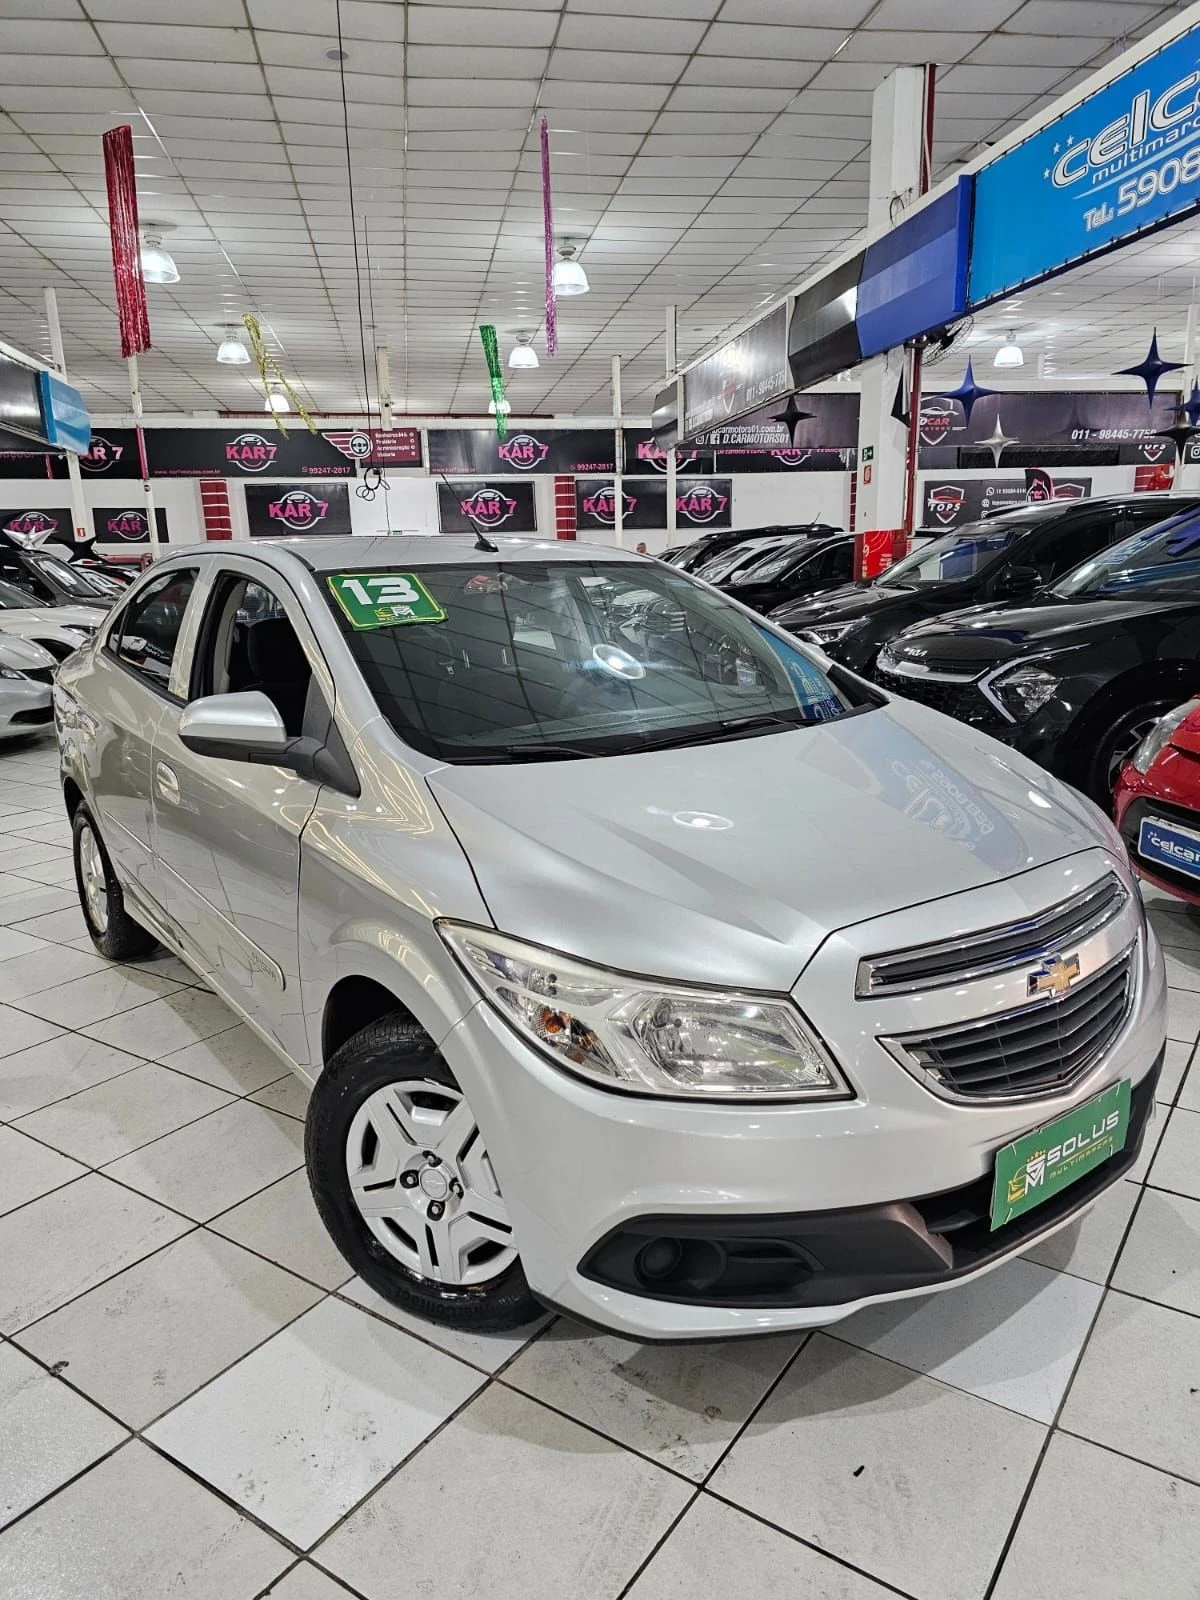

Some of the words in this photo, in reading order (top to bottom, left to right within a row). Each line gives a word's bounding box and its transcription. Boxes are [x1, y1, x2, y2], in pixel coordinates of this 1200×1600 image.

[1071, 429, 1090, 440] 011
[498, 446, 534, 459] KAR
[538, 445, 549, 458] 7
[269, 503, 312, 518] KAR
[317, 502, 329, 517] 7
[460, 501, 501, 514] KAR
[506, 501, 517, 513] 7
[718, 497, 729, 510] 7
[929, 503, 961, 512] TOPS
[107, 520, 141, 532] KAR
[341, 577, 420, 606] 13
[1046, 1110, 1120, 1167] SOLUS
